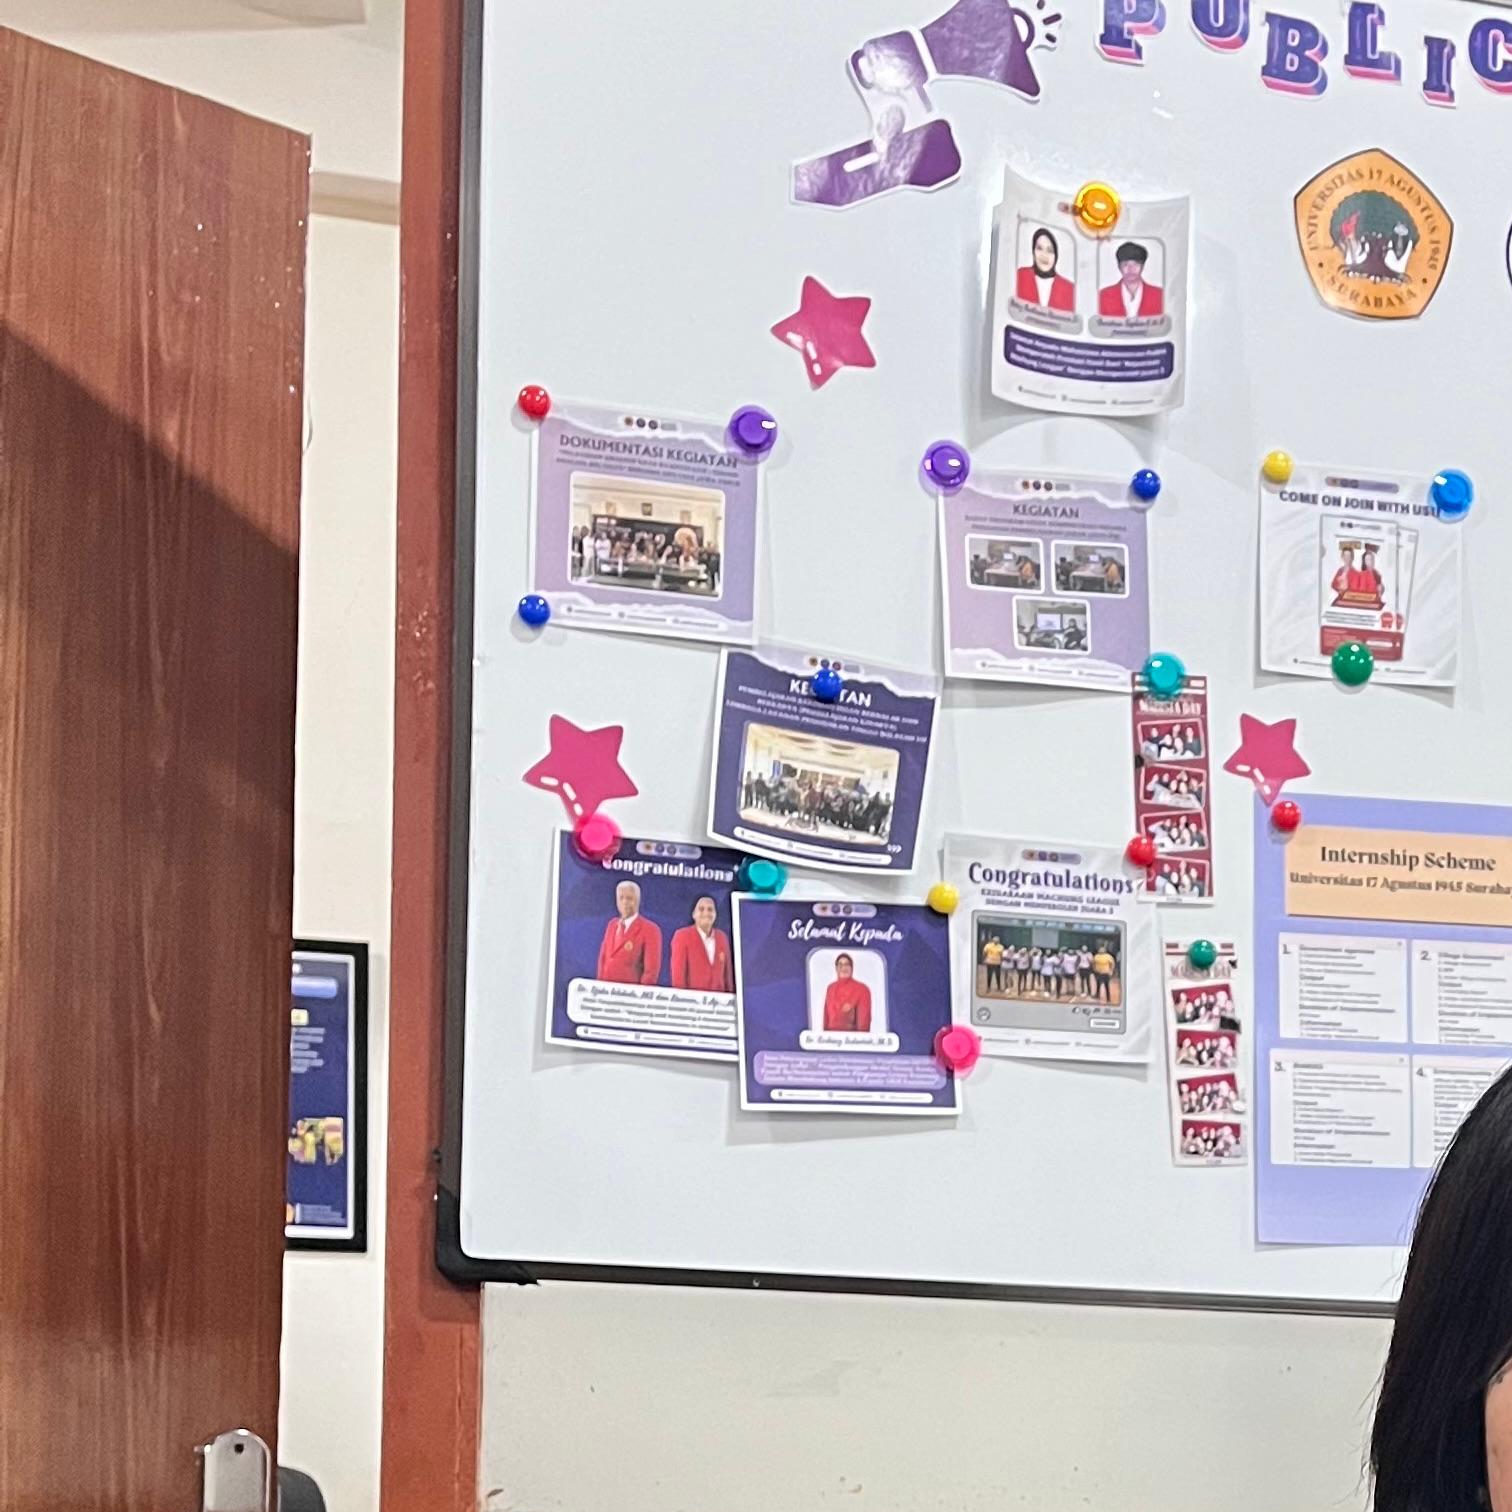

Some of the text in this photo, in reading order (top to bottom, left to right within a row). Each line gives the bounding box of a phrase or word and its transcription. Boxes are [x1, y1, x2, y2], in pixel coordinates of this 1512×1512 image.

[1307, 167, 1364, 251] UNIVERSITAS
[559, 433, 738, 469] DOKUMENTASI KEGIATAN
[1012, 503, 1080, 519] KEGIATAN
[1279, 490, 1319, 506] COME
[1321, 495, 1342, 507] ON
[1344, 496, 1375, 512] JOIN
[1377, 501, 1410, 515] WITH
[1319, 845, 1497, 872] Internship Scheme
[968, 861, 1134, 895] Congratulations
[1289, 871, 1364, 888] Universitas
[1366, 876, 1378, 888] 17
[1380, 876, 1432, 893] Agustus
[788, 919, 904, 946] Selamat Kepada
